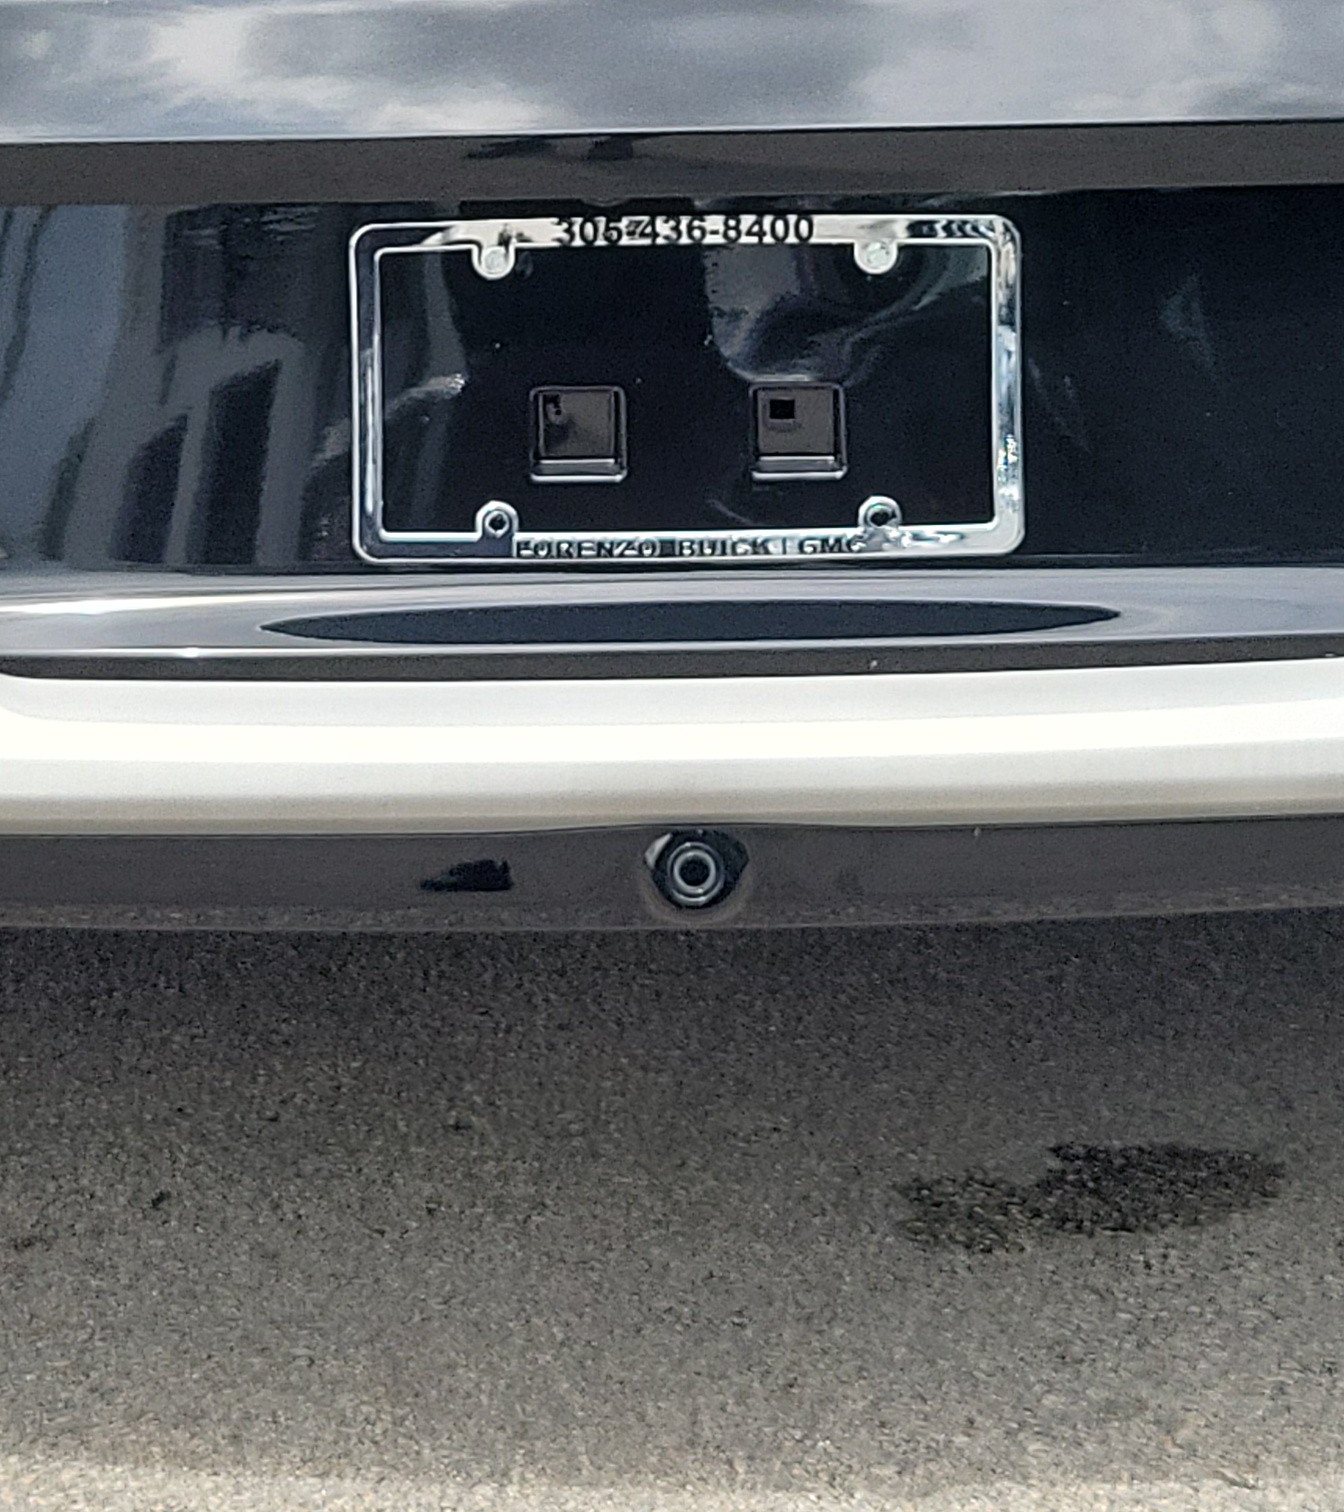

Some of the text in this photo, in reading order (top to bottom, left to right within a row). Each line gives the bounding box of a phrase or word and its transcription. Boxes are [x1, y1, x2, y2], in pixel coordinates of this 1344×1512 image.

[552, 215, 814, 247] 305-436-8400
[515, 535, 866, 559] LORENZO BUICK GMC
